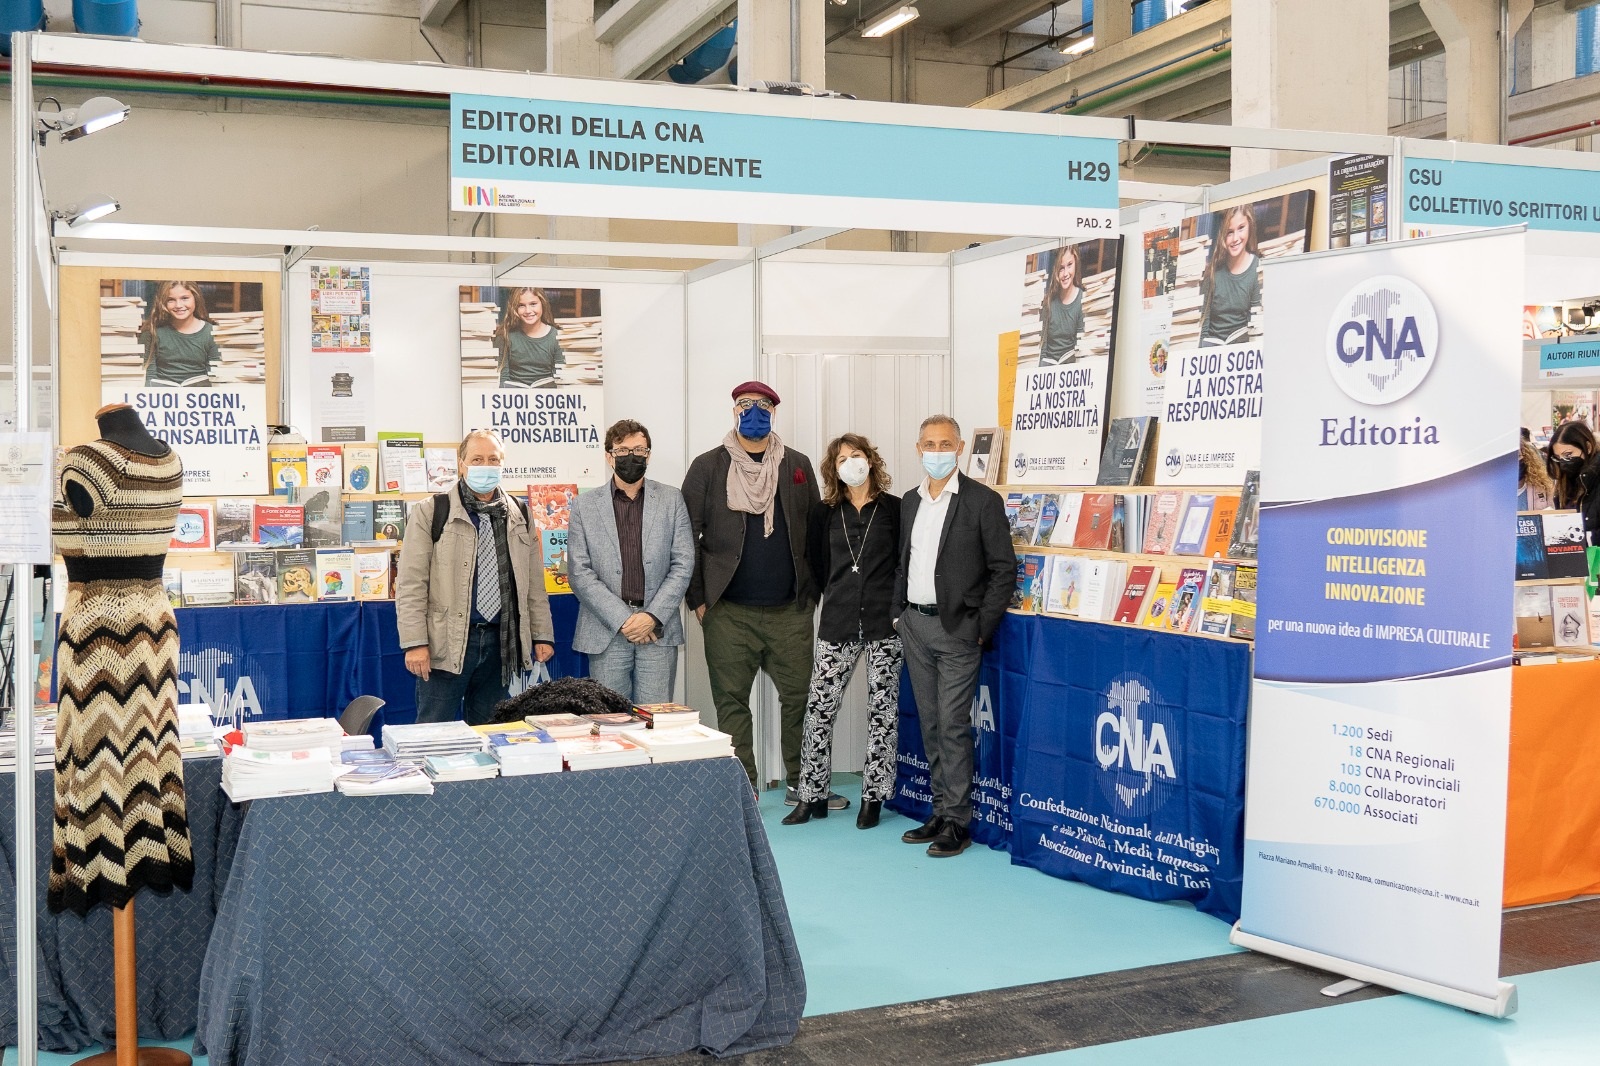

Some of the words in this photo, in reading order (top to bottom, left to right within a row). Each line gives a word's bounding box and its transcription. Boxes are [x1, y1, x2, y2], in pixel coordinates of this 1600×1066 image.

[462, 109, 561, 134] EDITORI
[572, 116, 646, 140] DELLA
[654, 122, 704, 143] CNA
[462, 142, 580, 169] EDITORIA
[589, 150, 762, 179] INDIPENDENTE
[1068, 160, 1110, 182] H29
[1409, 169, 1442, 186] CSU
[1409, 195, 1502, 216] COLLETTIVO
[1508, 201, 1587, 221] SCRITTORI
[1077, 217, 1102, 228] PAD.
[1105, 219, 1112, 229] 2
[1336, 316, 1425, 364] CNA
[1181, 358, 1185, 376] I
[1190, 354, 1221, 376] SUOI
[1547, 351, 1575, 361] AUTORI
[1026, 374, 1030, 391] I
[1032, 371, 1056, 391] SUOI
[1059, 368, 1093, 389] SOGNI,
[1187, 379, 1201, 398] LA
[1208, 373, 1262, 397] NOSTRA
[136, 393, 179, 408] SUOI
[186, 393, 246, 411] SOGNI,
[482, 394, 486, 409] I
[492, 394, 528, 409] SUOI
[535, 394, 586, 411] SOGNI,
[1030, 393, 1045, 411] LA
[1045, 390, 1086, 410] NOSTRA
[164, 411, 236, 427] NOSTRA
[492, 412, 510, 426] LA
[516, 411, 578, 426] NOSTRA
[1015, 406, 1098, 431] RESPONSABILITÀ
[1319, 416, 1440, 446] Editoria
[1015, 457, 1026, 468] CNA
[1166, 456, 1181, 466] CNA
[1186, 454, 1196, 462] CNA
[1211, 453, 1235, 461] IMPRESE
[1218, 519, 1229, 535] 26
[1326, 527, 1427, 547] CONDIVISIONE
[1326, 555, 1426, 576] INTELLIGENZA
[1325, 583, 1425, 606] INNOVAZIONE
[1268, 620, 1284, 633] per
[1285, 620, 1303, 633] una
[1306, 623, 1336, 635] nuova
[1338, 622, 1360, 637] idea
[1363, 624, 1372, 638] di
[1376, 624, 1424, 643] IMPRESA
[1427, 629, 1491, 648] CULTURALE
[1332, 724, 1363, 738] 1.200
[1366, 728, 1392, 742] Sedi
[1095, 712, 1176, 778] CNA
[1349, 745, 1362, 757] 18
[1366, 747, 1392, 762] CNA
[1395, 751, 1455, 771] Regionali
[1341, 763, 1361, 776] 103
[1365, 766, 1391, 781] CNA
[1395, 770, 1460, 792] Provinciali
[1329, 780, 1361, 795] 8.000
[1364, 785, 1446, 810] Collaboratori
[986, 810, 995, 823] di
[1020, 793, 1098, 826] Confederazione
[1314, 797, 1360, 814] 670.000
[1364, 805, 1418, 824] Associati
[1094, 853, 1162, 881] Provinciale
[1166, 870, 1178, 886] di
[1157, 848, 1209, 872] Impresa
[1259, 852, 1274, 861] Piazza
[1275, 855, 1297, 866] Mariano
[1298, 860, 1323, 872] Armellini,
[1324, 866, 1333, 874] 9/a
[1338, 869, 1354, 879] 00162
[1356, 873, 1372, 883] Roma,
[1375, 878, 1439, 898] comunicazione@cna.it
[1444, 893, 1479, 907] www.cna.it
